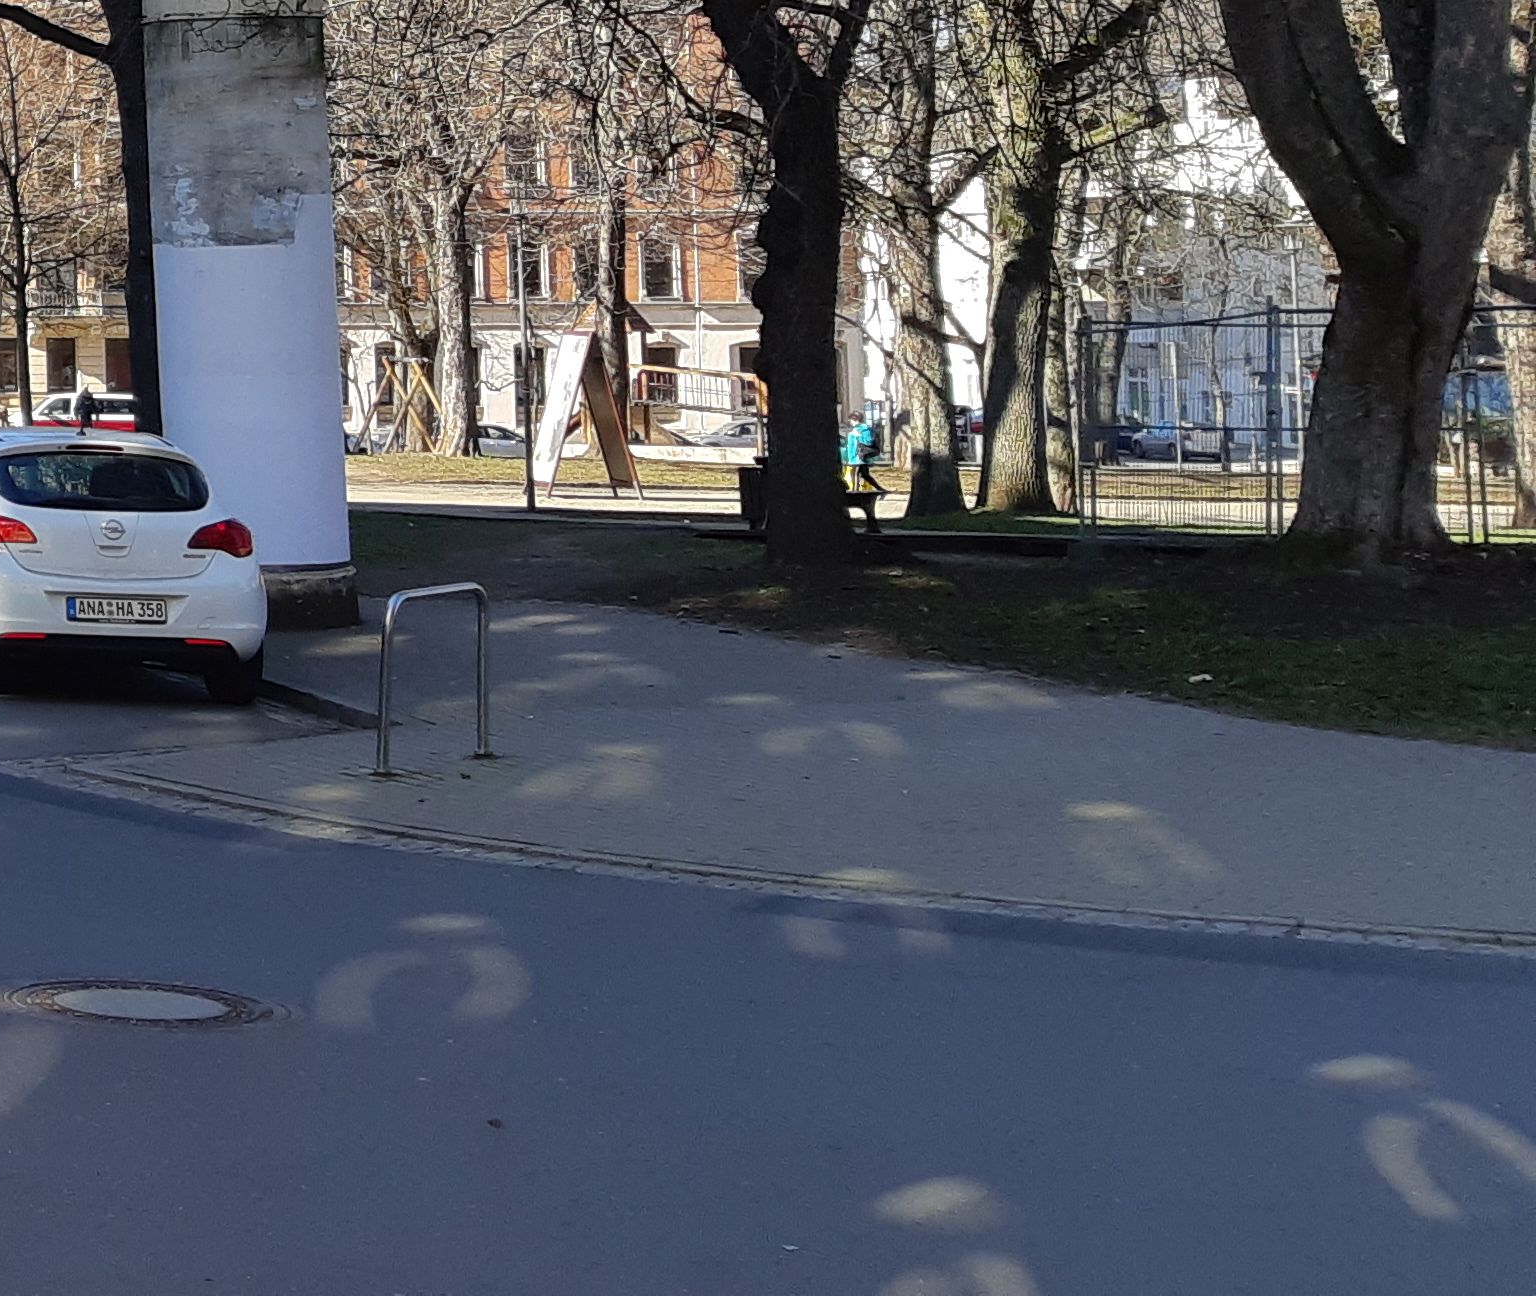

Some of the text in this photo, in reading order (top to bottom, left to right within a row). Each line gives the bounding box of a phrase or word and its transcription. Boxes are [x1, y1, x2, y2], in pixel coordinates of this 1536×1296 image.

[78, 600, 164, 618] ANA HA 358
